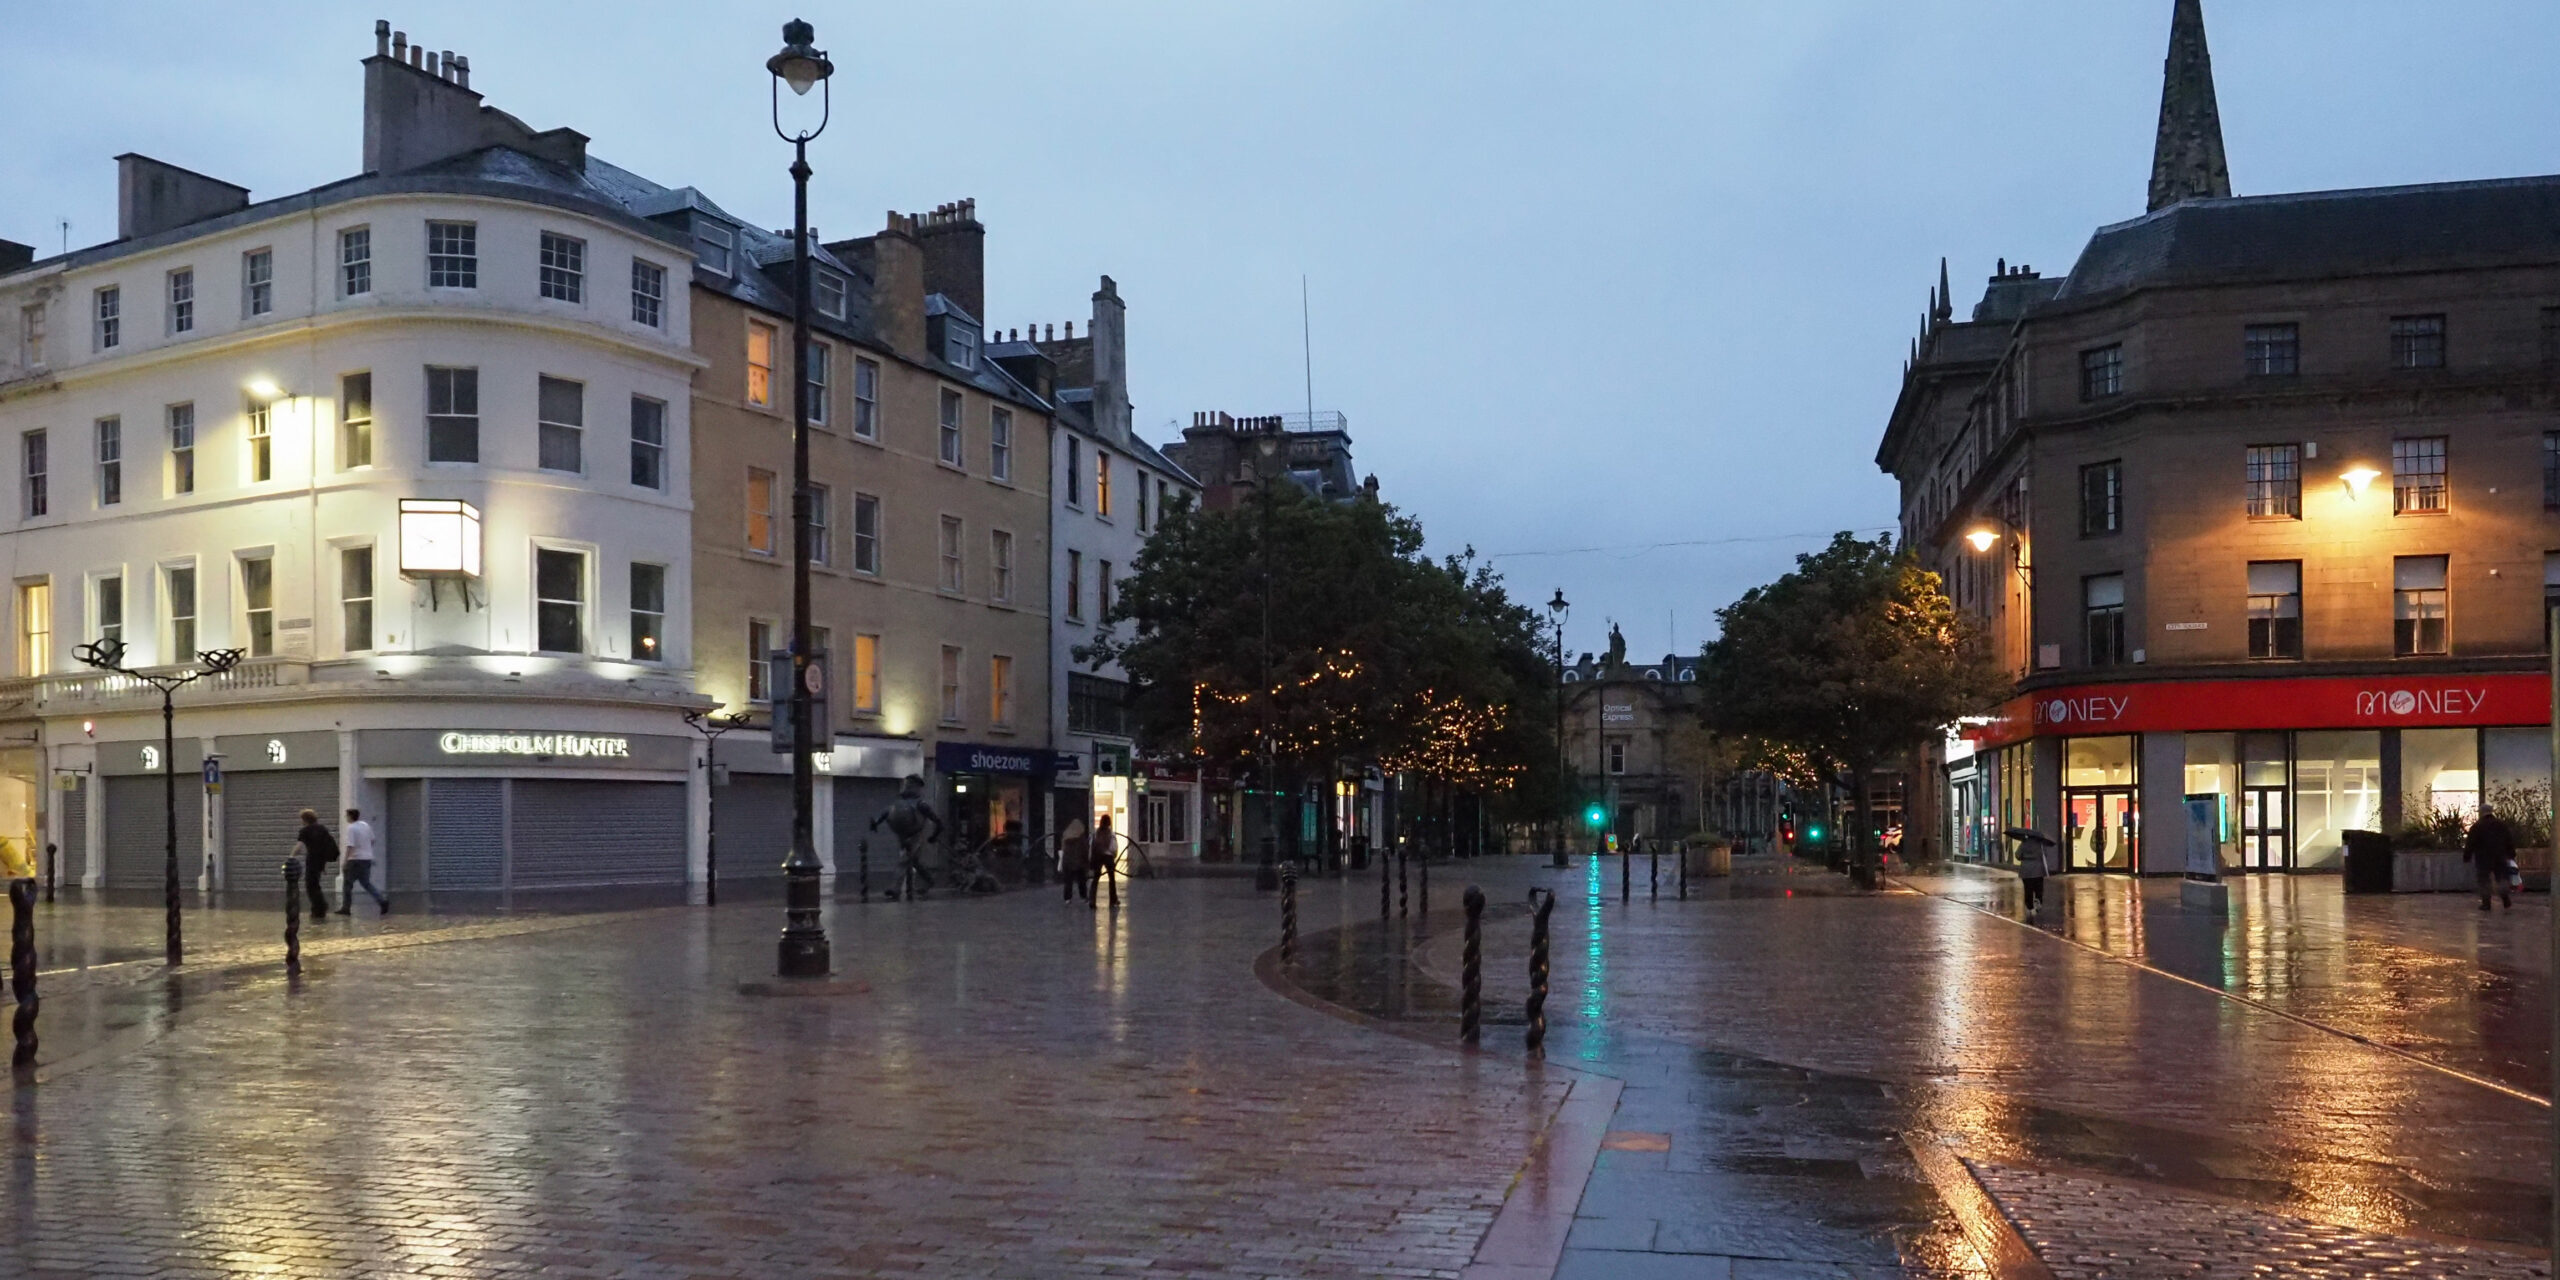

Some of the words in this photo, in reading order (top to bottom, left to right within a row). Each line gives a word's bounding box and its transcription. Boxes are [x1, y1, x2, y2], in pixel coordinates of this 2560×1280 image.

[2034, 696, 2128, 724] MONEY
[2357, 689, 2486, 715] MONEY
[1602, 713, 1634, 721] Express
[440, 733, 553, 754] CHISHOLM
[555, 735, 630, 757] HUNTER
[971, 751, 1030, 770] shoezone
